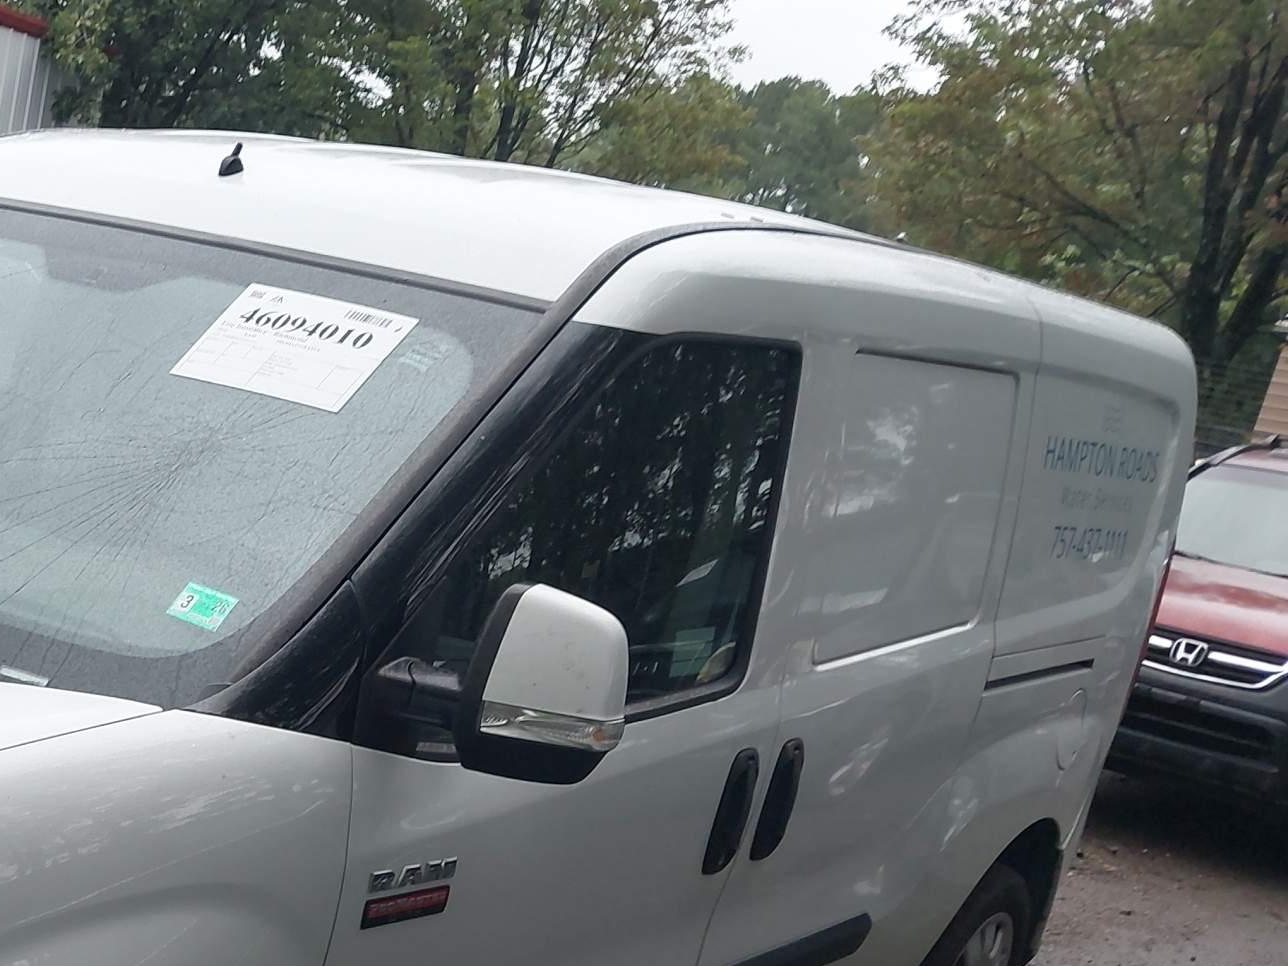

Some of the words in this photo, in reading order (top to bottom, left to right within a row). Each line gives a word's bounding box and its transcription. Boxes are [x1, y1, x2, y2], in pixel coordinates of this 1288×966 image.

[239, 307, 374, 350] 46094010
[1043, 435, 1114, 477] HAMPTON
[1115, 447, 1161, 484] ROADS
[180, 594, 194, 608] 3
[367, 856, 458, 894] RAM
